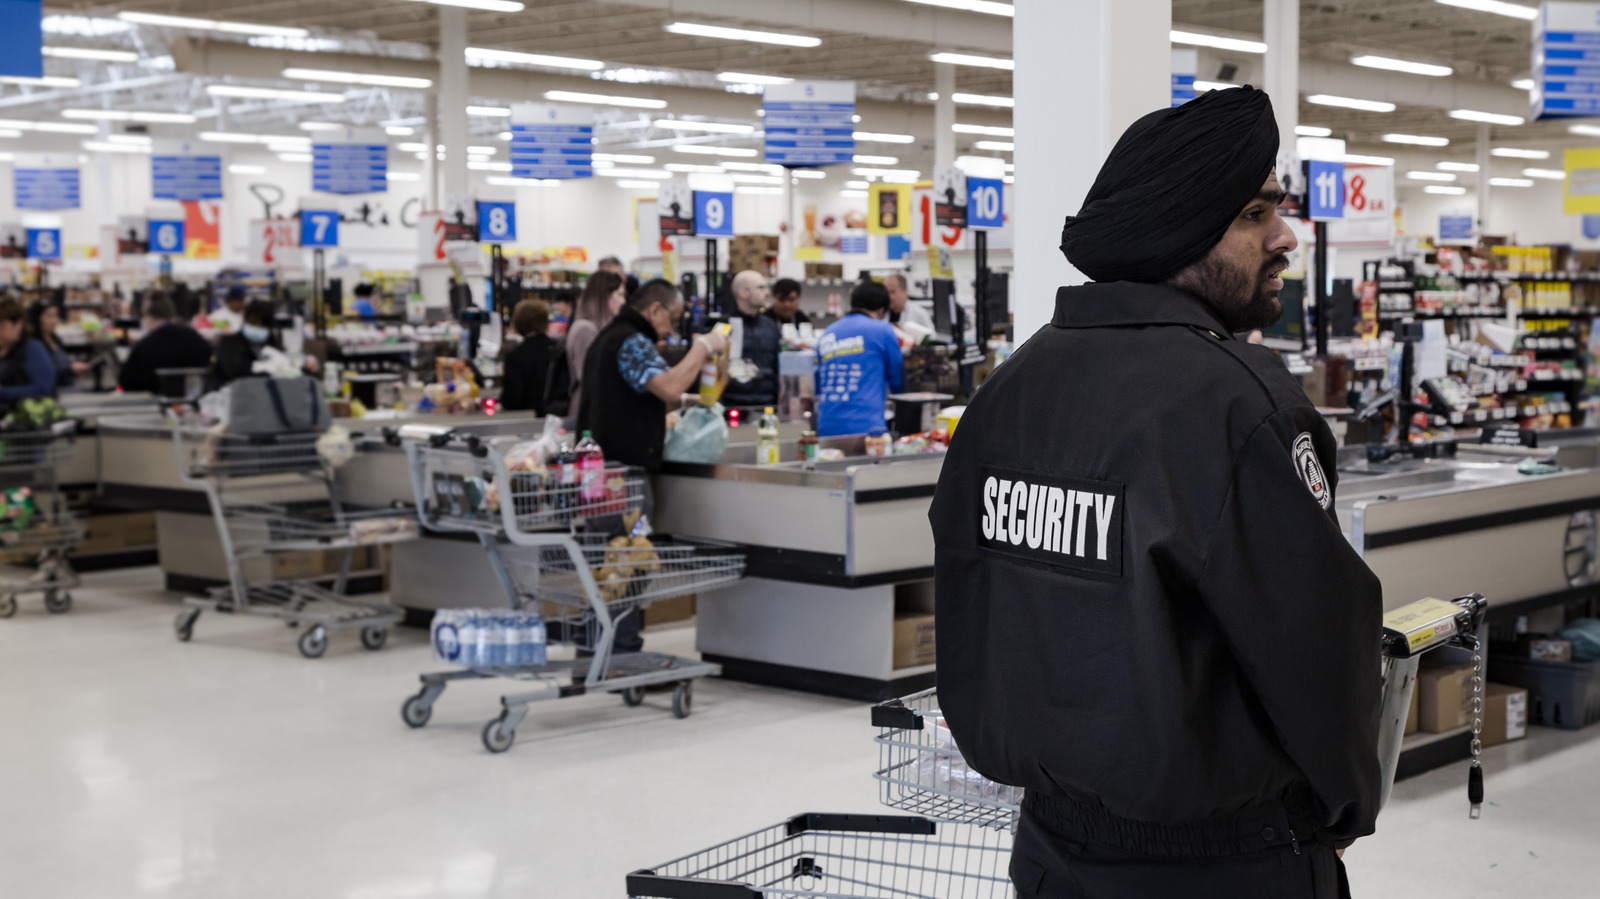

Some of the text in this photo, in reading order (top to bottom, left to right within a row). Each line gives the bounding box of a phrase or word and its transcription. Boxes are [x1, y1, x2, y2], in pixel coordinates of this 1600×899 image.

[971, 186, 1000, 220] 10
[1315, 171, 1337, 209] 11
[311, 215, 330, 242] 7
[489, 207, 508, 236] 8
[705, 198, 725, 229] 9
[36, 231, 56, 254] 5
[157, 224, 177, 250] 6
[982, 476, 1116, 560] SECURITY
